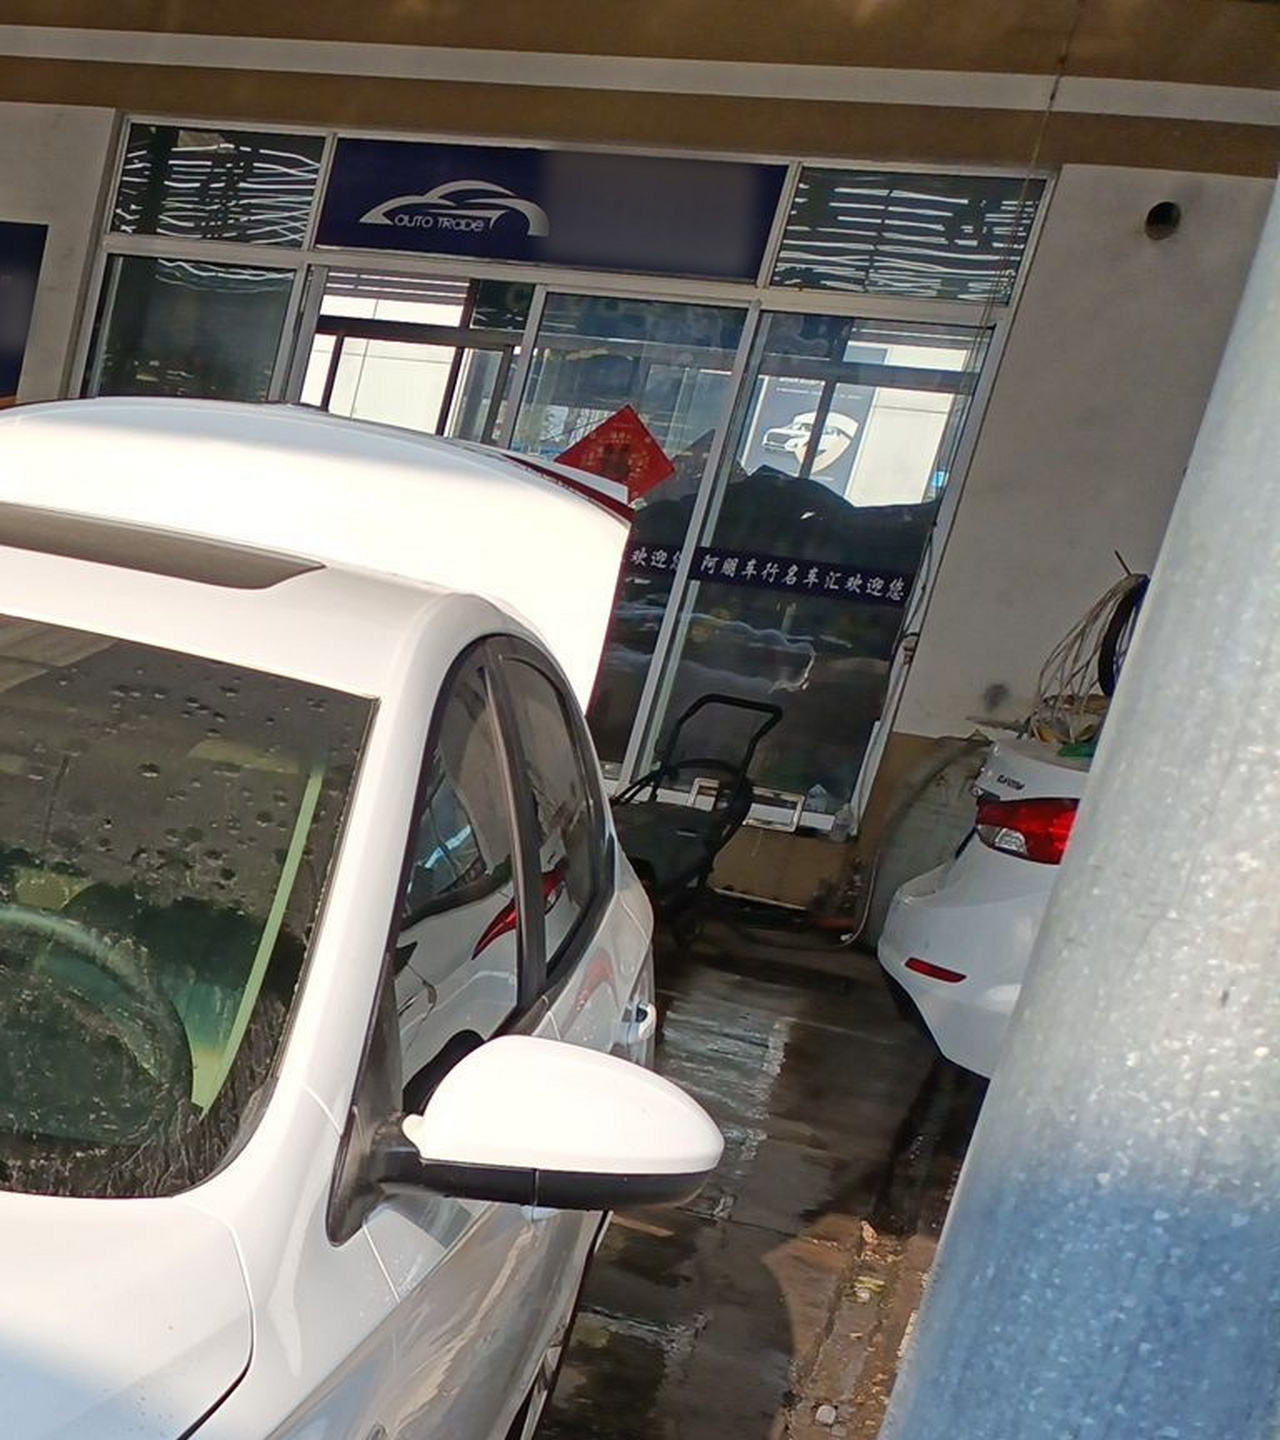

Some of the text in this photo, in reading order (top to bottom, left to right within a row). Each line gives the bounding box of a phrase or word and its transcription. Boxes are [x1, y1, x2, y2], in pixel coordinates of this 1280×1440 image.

[700, 553, 905, 601] 阿朋车行名车汇欢迎您
